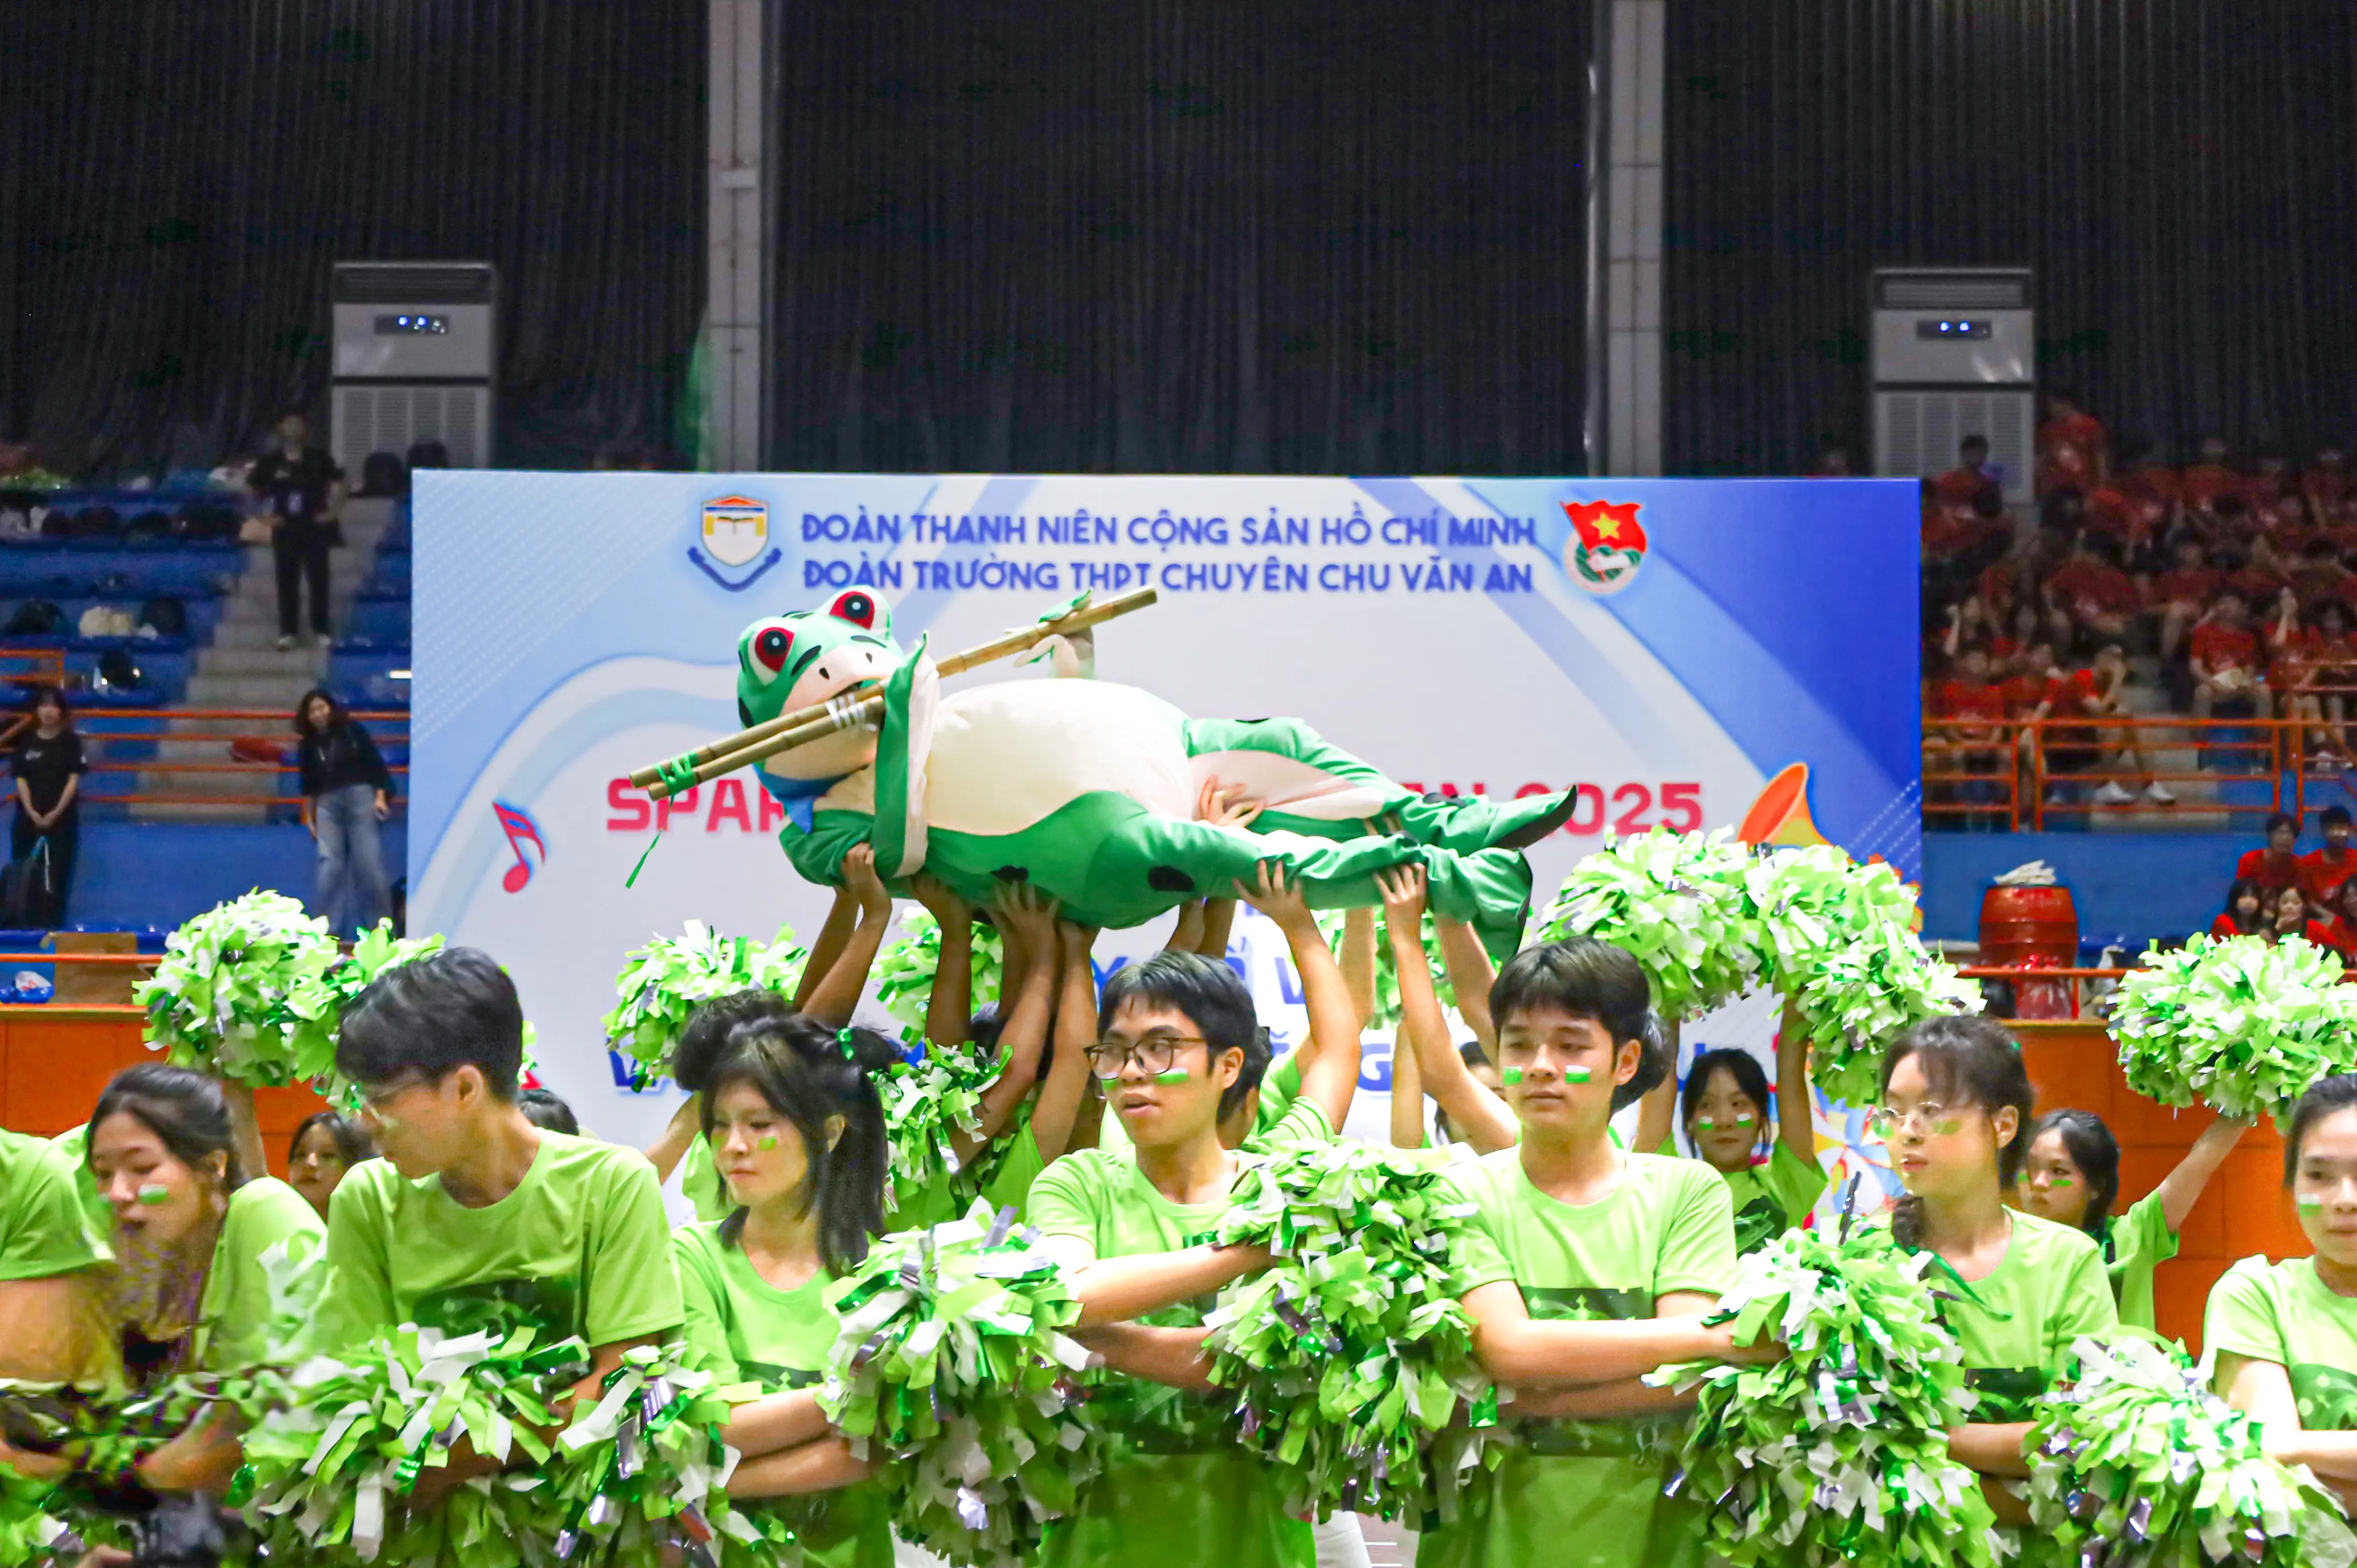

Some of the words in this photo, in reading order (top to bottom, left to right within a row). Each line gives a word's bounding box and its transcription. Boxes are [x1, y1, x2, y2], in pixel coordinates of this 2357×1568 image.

[801, 504, 900, 544] ĐOÀN
[911, 514, 1026, 544] THANH
[1038, 508, 1117, 544] NIÊN
[1128, 508, 1228, 552] CỘNG
[1241, 507, 1309, 545] SẢN
[1321, 502, 1372, 545] HỒ
[1381, 509, 1438, 546] CHÍ
[1448, 517, 1535, 547] MINH
[803, 552, 901, 590] ĐOÀN
[913, 554, 1059, 590] TRƯỜNG
[1070, 562, 1151, 590] THPT
[1161, 555, 1308, 591] CHUYÊN
[1318, 563, 1390, 591] CHU
[1401, 555, 1474, 591] VĂN
[1483, 564, 1534, 592] AN
